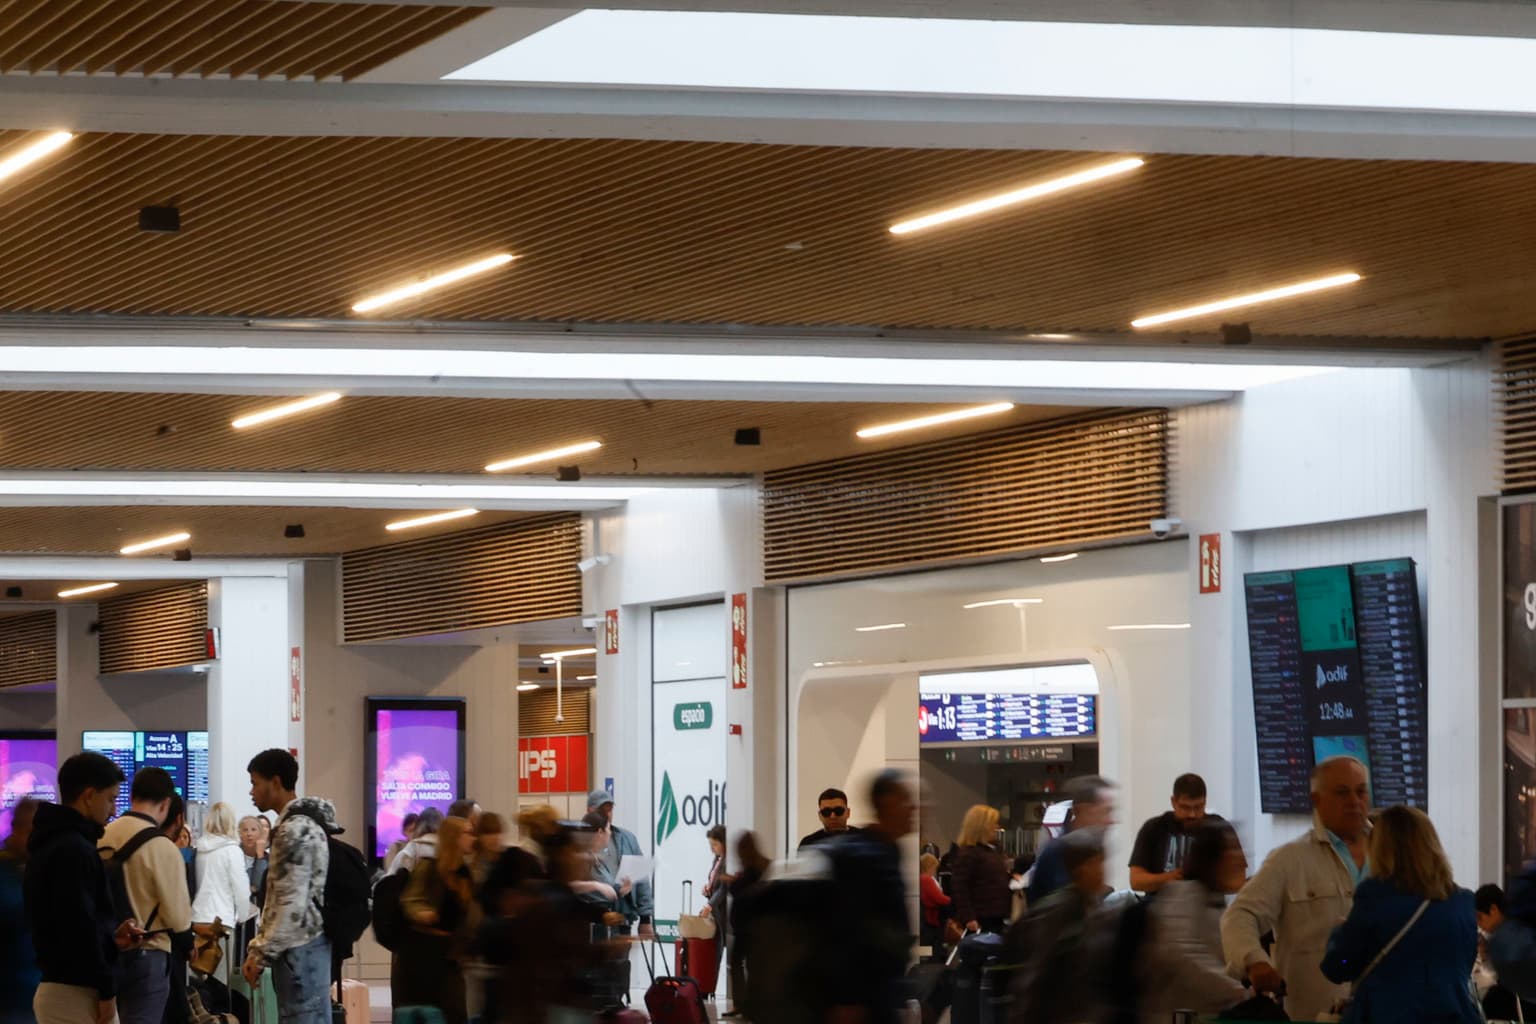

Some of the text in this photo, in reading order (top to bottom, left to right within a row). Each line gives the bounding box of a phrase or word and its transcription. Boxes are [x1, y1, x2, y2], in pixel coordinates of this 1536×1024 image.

[681, 704, 705, 727] espacio
[170, 733, 178, 743] A
[519, 749, 557, 779] IPS
[407, 782, 450, 791] CONMIGO
[418, 792, 453, 801] MADRID
